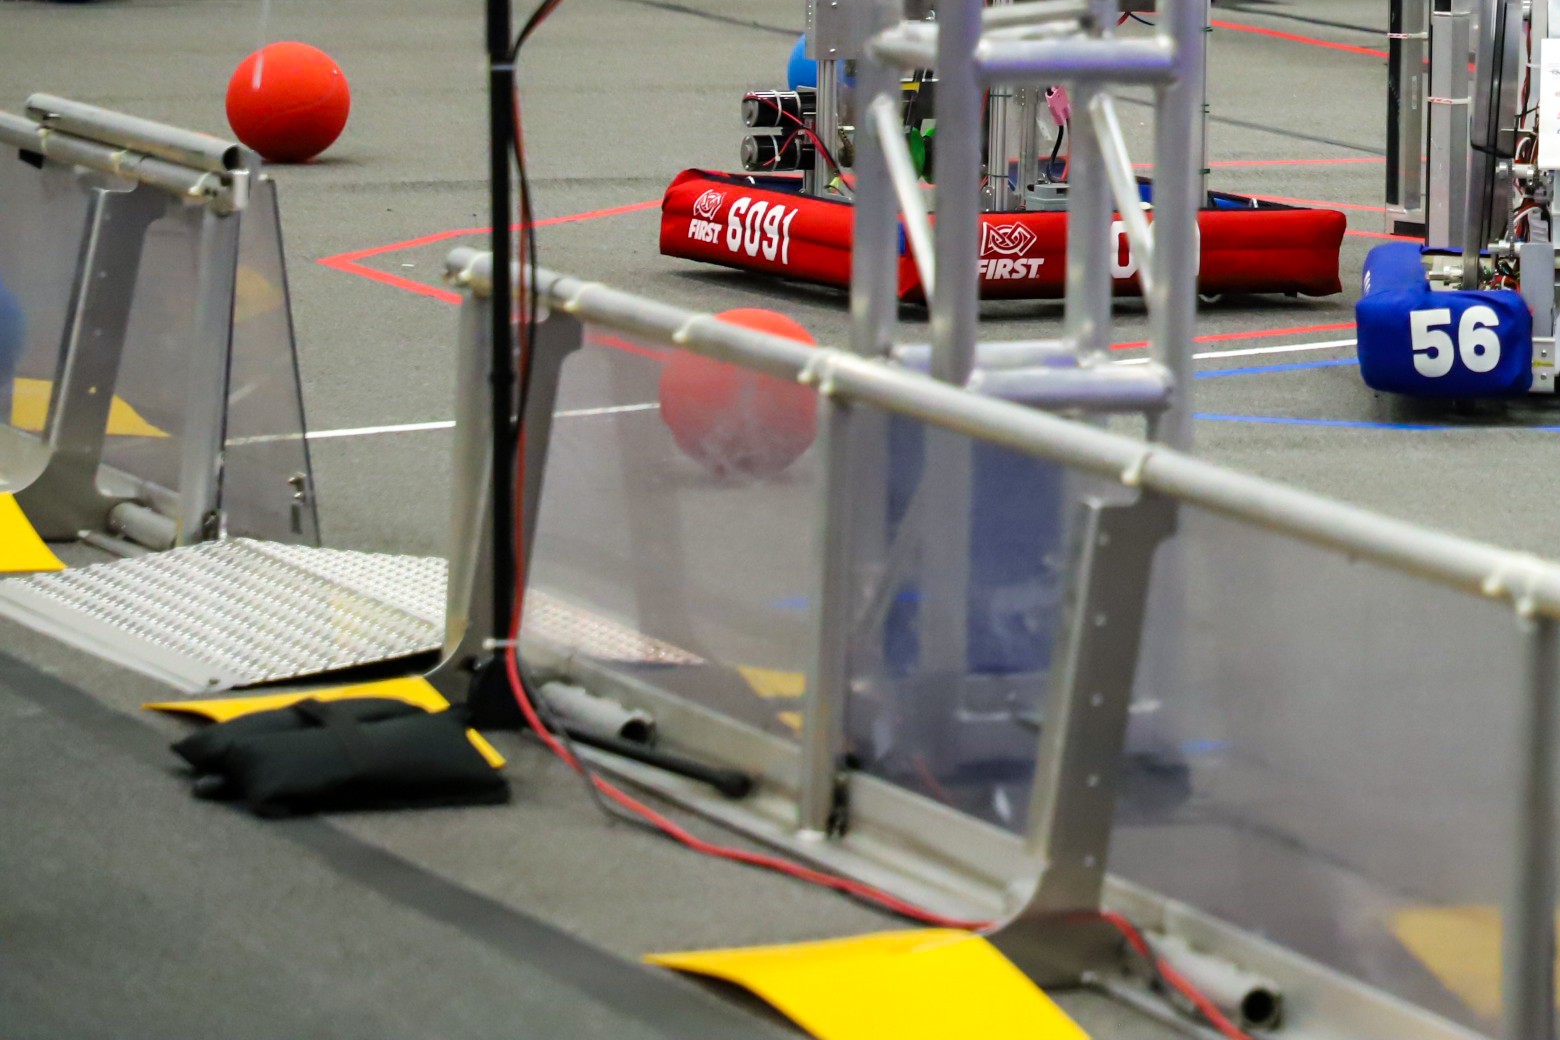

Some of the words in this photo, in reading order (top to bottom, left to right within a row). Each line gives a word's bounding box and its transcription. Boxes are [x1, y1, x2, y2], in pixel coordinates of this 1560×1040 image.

[688, 218, 722, 245] FIRST
[726, 196, 799, 265] 6091
[976, 257, 1045, 280] FIRST
[1409, 305, 1501, 378] 56
